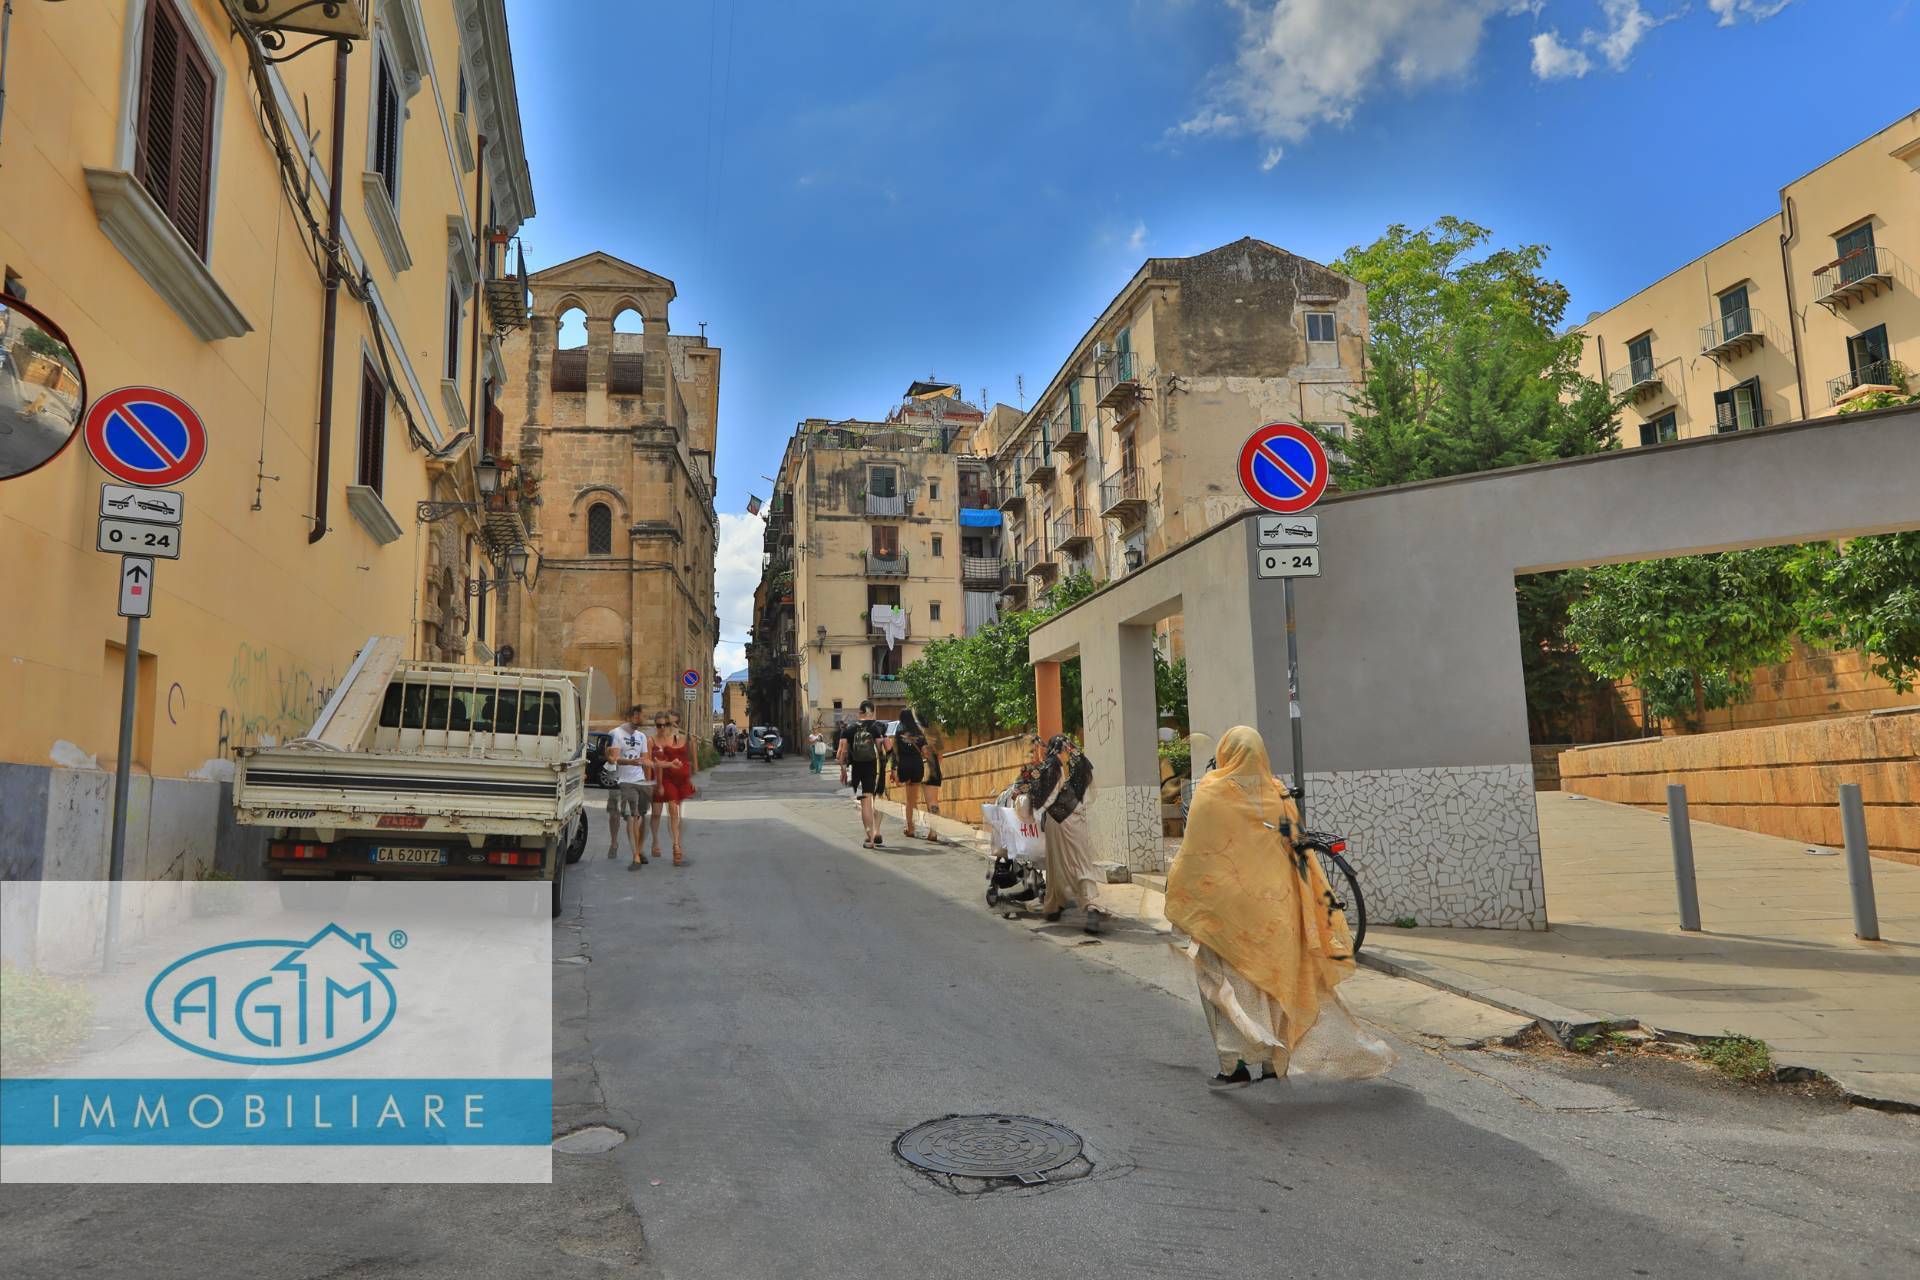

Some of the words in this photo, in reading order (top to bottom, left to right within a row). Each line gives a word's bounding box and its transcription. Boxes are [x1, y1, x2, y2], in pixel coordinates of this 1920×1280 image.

[109, 529, 123, 543] 0
[144, 534, 171, 549] 24
[1265, 557, 1276, 569] 0
[1292, 556, 1313, 568] 24
[378, 848, 394, 861] CA
[398, 848, 438, 863] 620YZ
